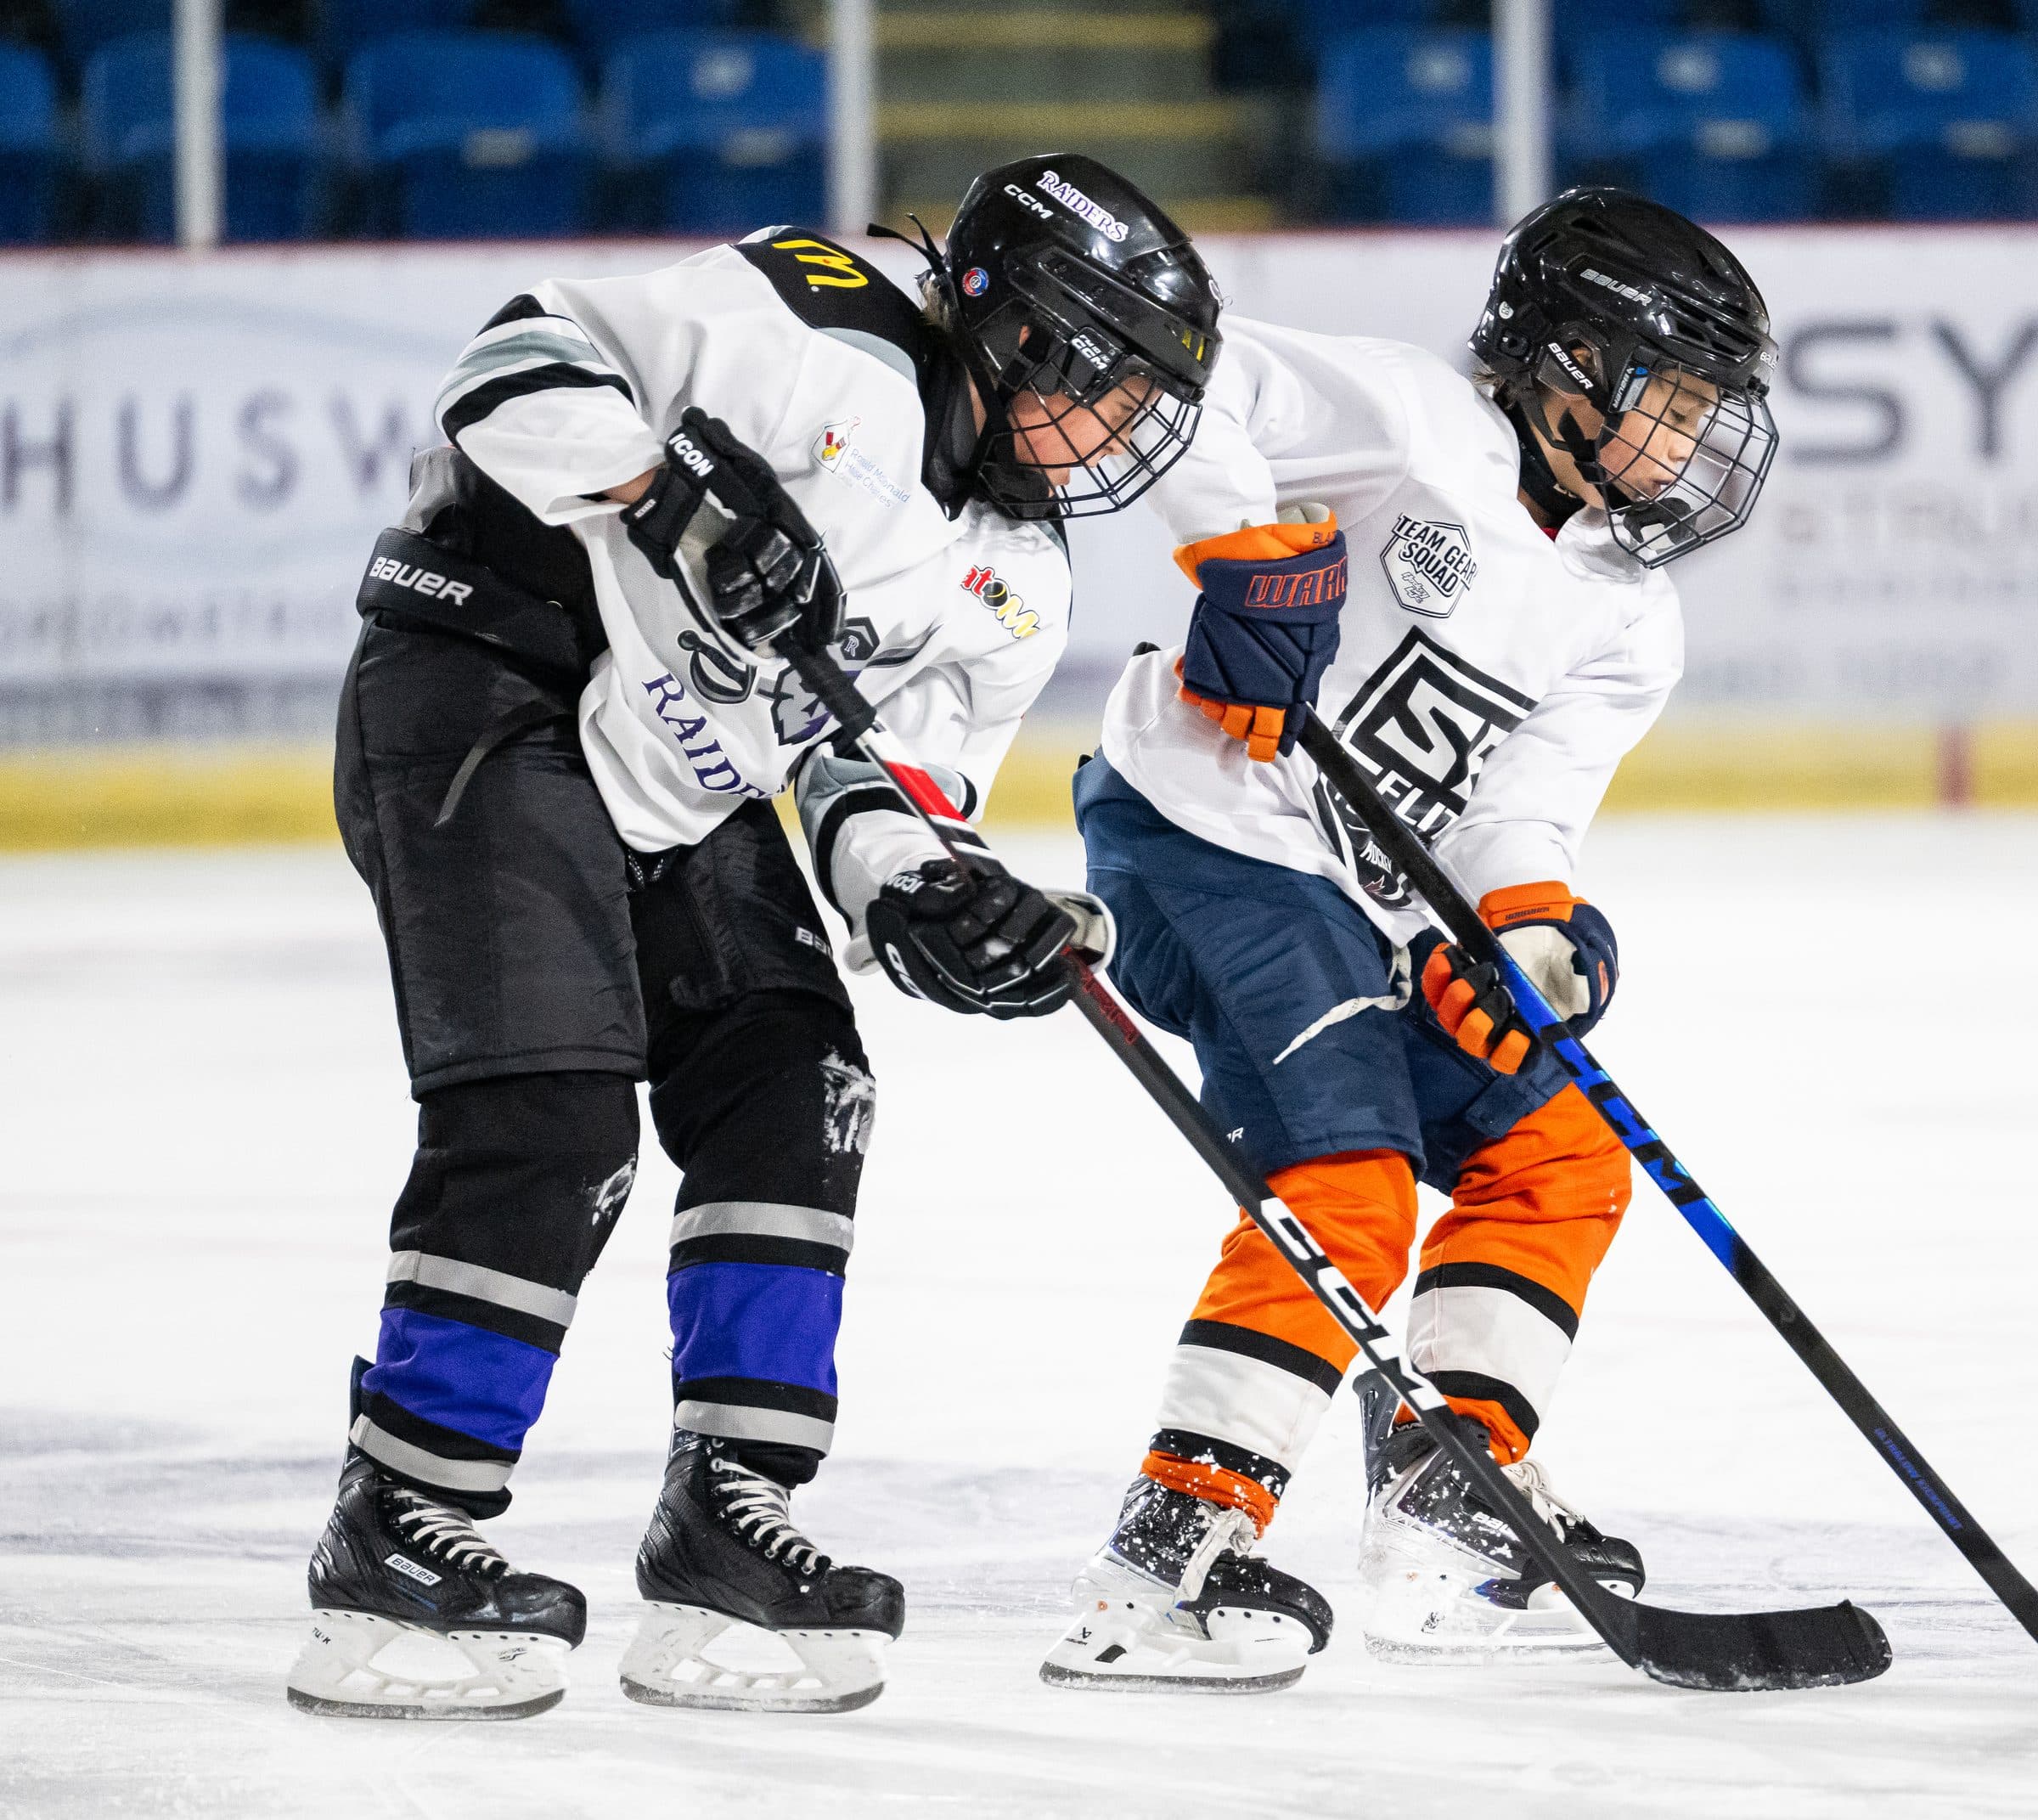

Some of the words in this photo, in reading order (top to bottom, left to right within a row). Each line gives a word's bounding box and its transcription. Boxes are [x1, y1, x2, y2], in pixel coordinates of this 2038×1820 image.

[1004, 184, 1053, 219] CCM
[1037, 171, 1129, 241] RAIDERS
[1580, 268, 1652, 307] BAUER
[1072, 338, 1107, 370] CCM
[1548, 342, 1593, 390] BAUER
[668, 433, 714, 476] ICON
[1397, 515, 1447, 552] TEAM
[1444, 545, 1477, 583] GEAR
[1402, 542, 1458, 593] SQUAD
[369, 555, 475, 606] BAUER
[1260, 1197, 1448, 1411] CCM
[391, 1558, 436, 1583] BAUER
[312, 1626, 332, 1645] TUK
